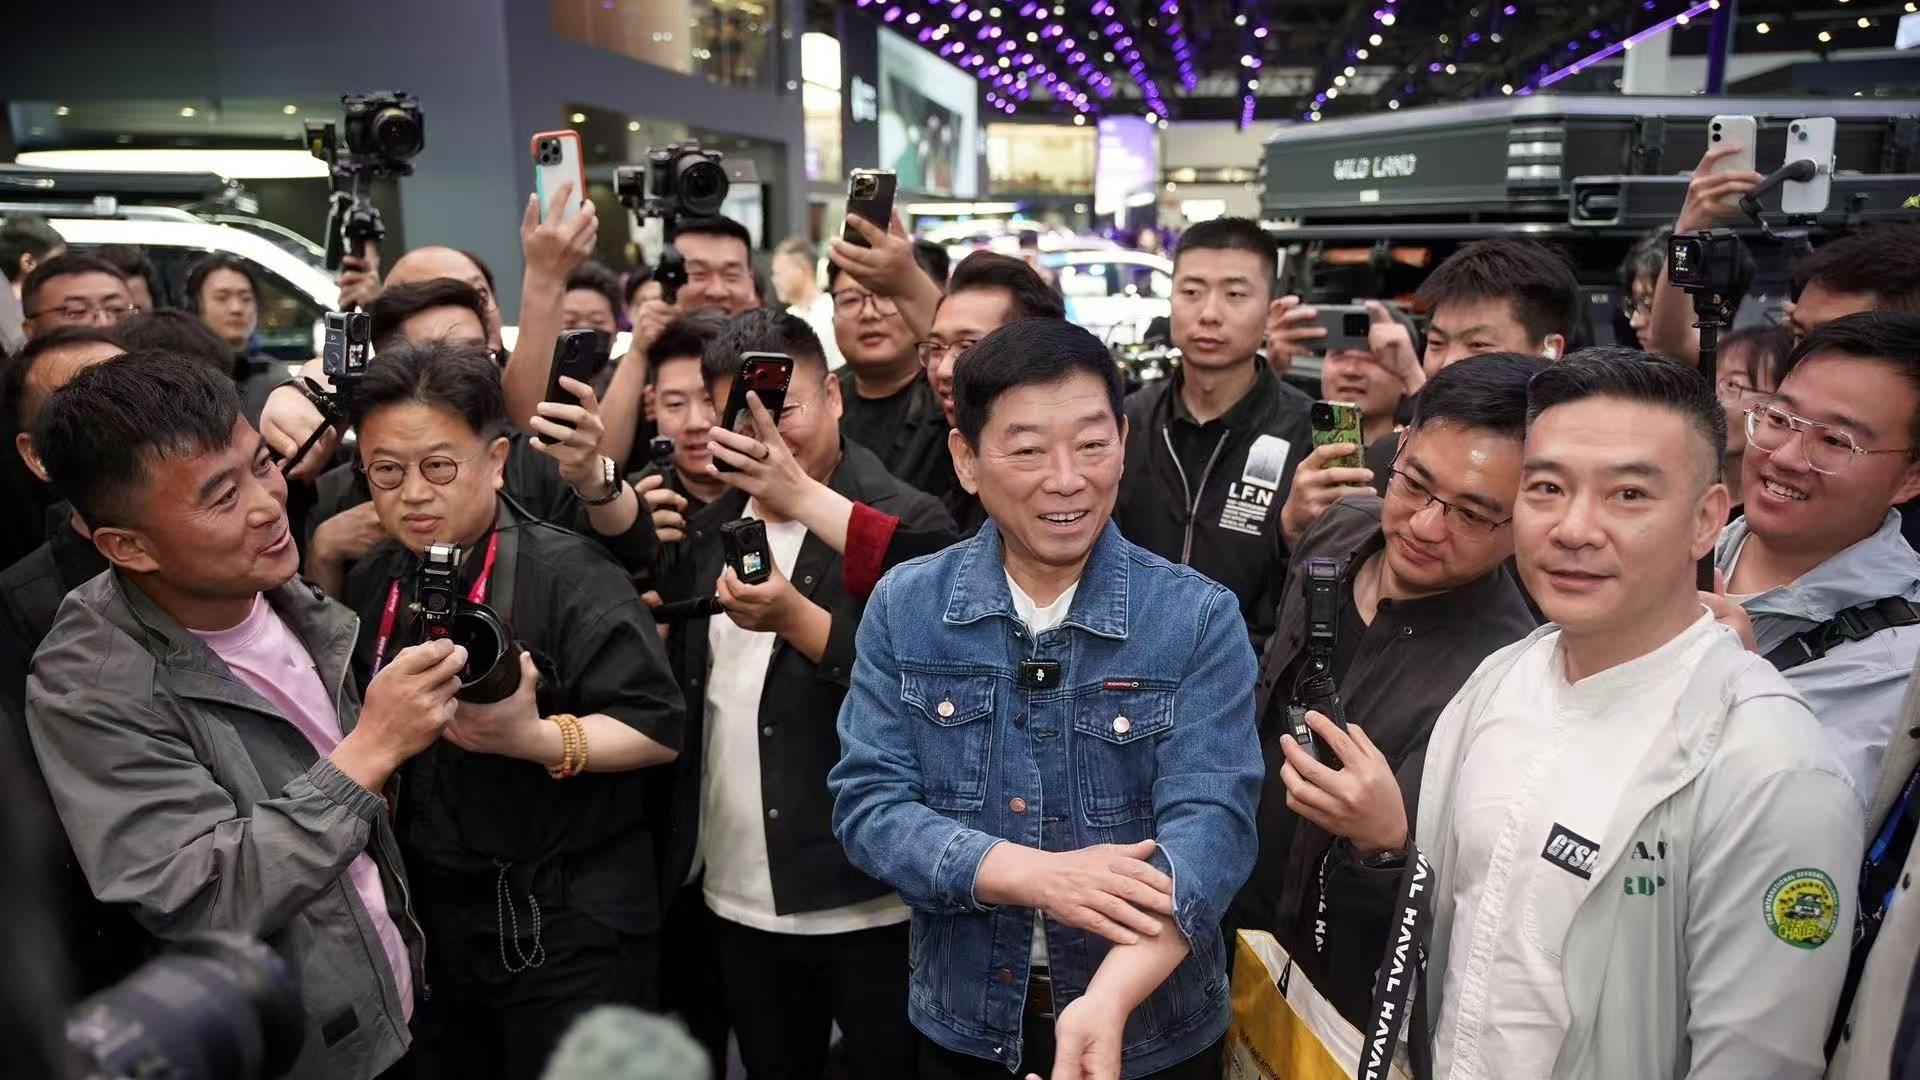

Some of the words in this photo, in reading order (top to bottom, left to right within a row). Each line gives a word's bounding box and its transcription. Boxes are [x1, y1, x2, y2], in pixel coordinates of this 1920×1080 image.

[1373, 153, 1417, 178] LAND
[1386, 907, 1417, 992] HAVAL
[1365, 1001, 1395, 1080] HAVAL
